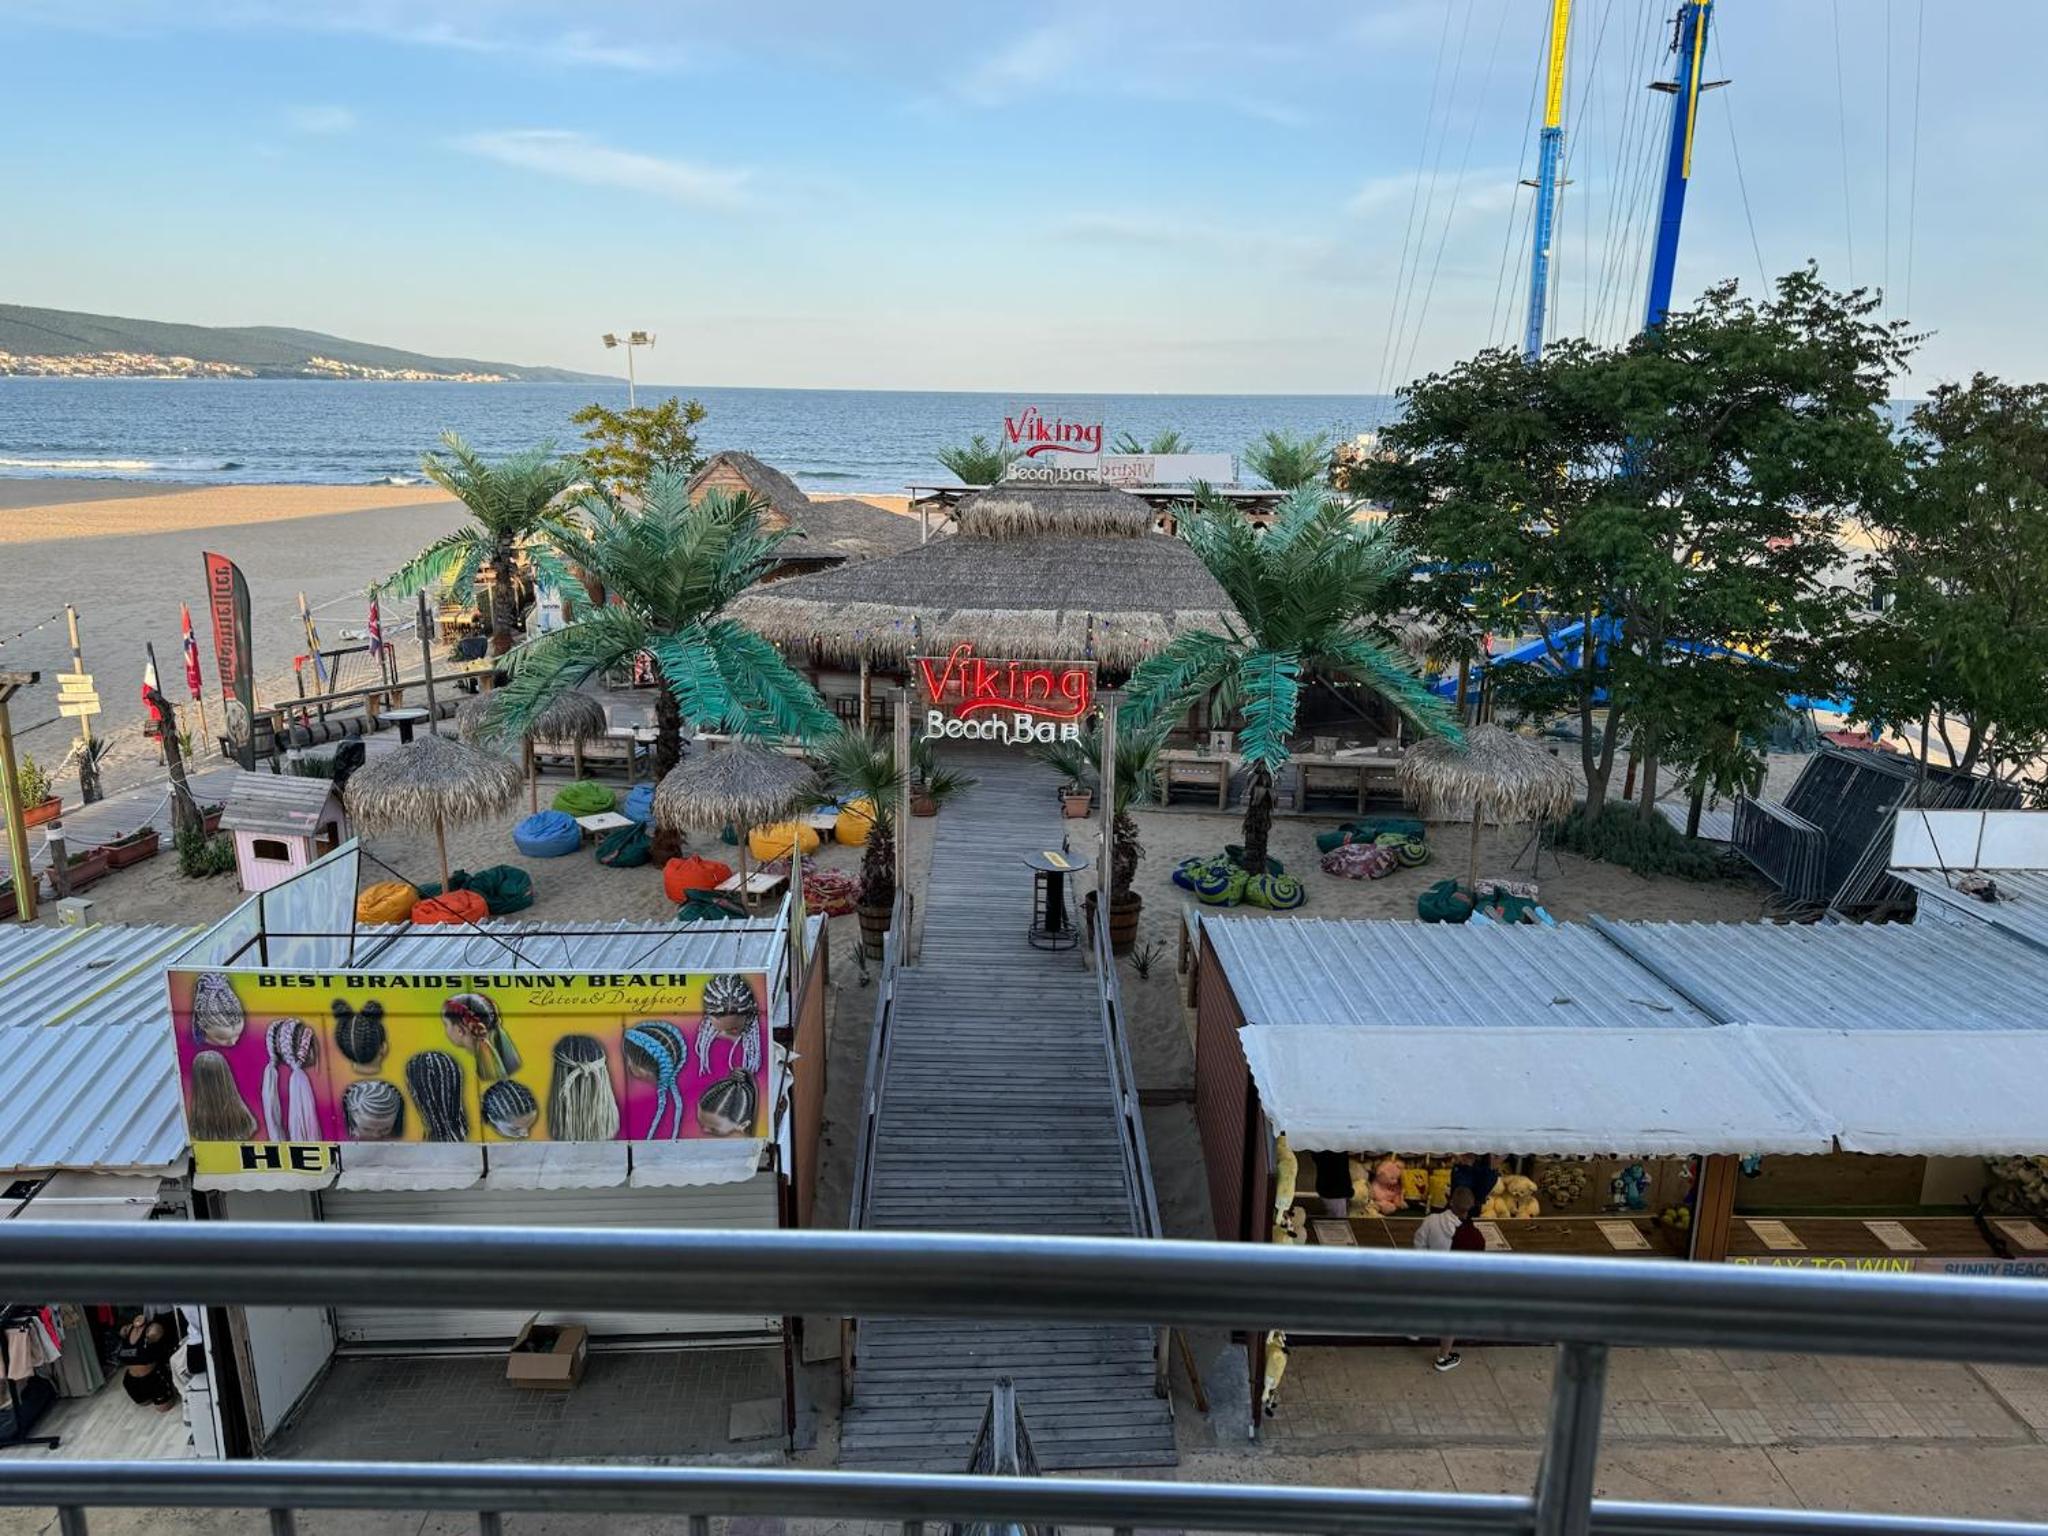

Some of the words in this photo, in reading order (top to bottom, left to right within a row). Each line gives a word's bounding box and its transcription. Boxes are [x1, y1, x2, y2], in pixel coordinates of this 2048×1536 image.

[1004, 405, 1102, 458] Viking
[1000, 462, 1055, 485] Beach
[919, 642, 1089, 718] Viking
[920, 709, 1012, 746] Beach
[258, 974, 334, 988] BEST
[346, 975, 463, 988] BRAIDS
[474, 974, 577, 988] SUNNY
[588, 974, 688, 988] BEACH
[1855, 1258, 1909, 1275] WIN
[1944, 1262, 1999, 1276] SUNNY
